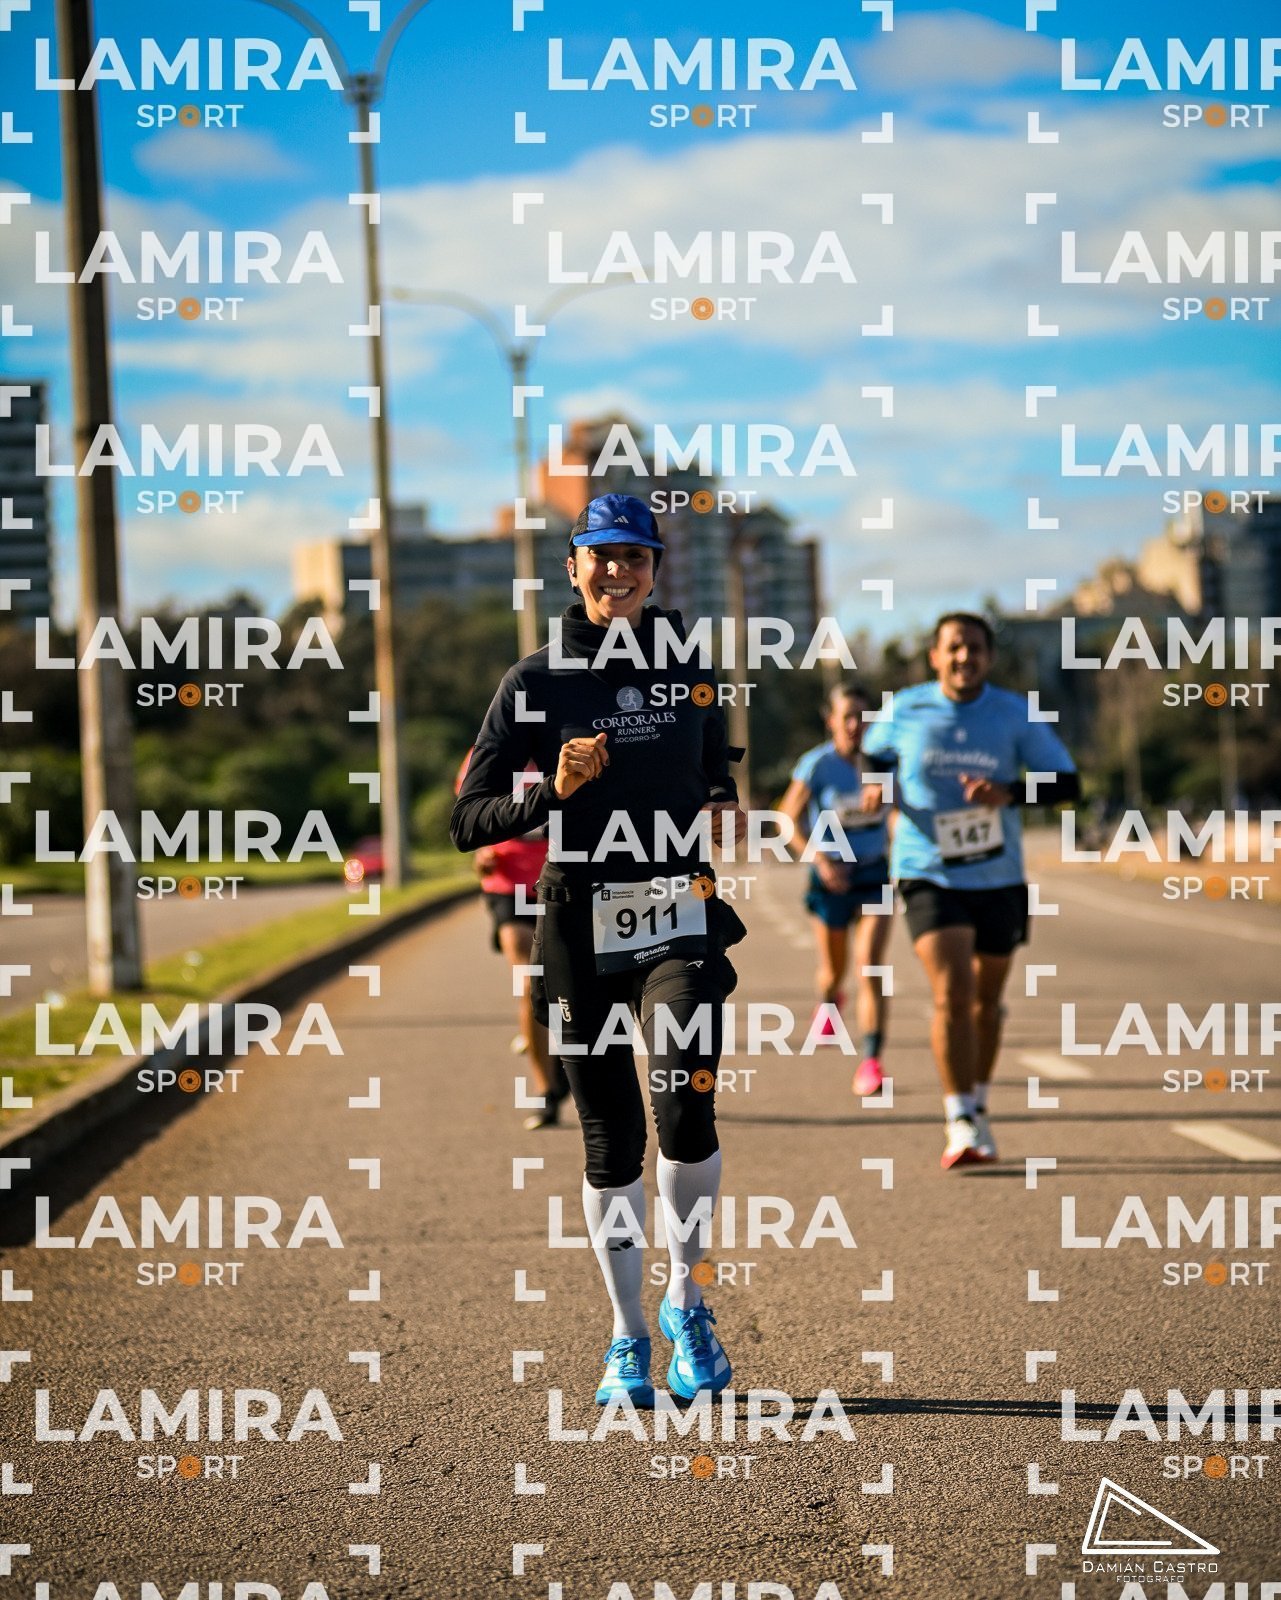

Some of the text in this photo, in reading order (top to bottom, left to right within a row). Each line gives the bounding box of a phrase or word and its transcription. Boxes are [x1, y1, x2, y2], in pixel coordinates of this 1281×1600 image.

[592, 712, 676, 730] CORPORALES
[617, 726, 656, 736] RUNNERS
[952, 822, 990, 847] 147
[616, 903, 677, 939] 911
